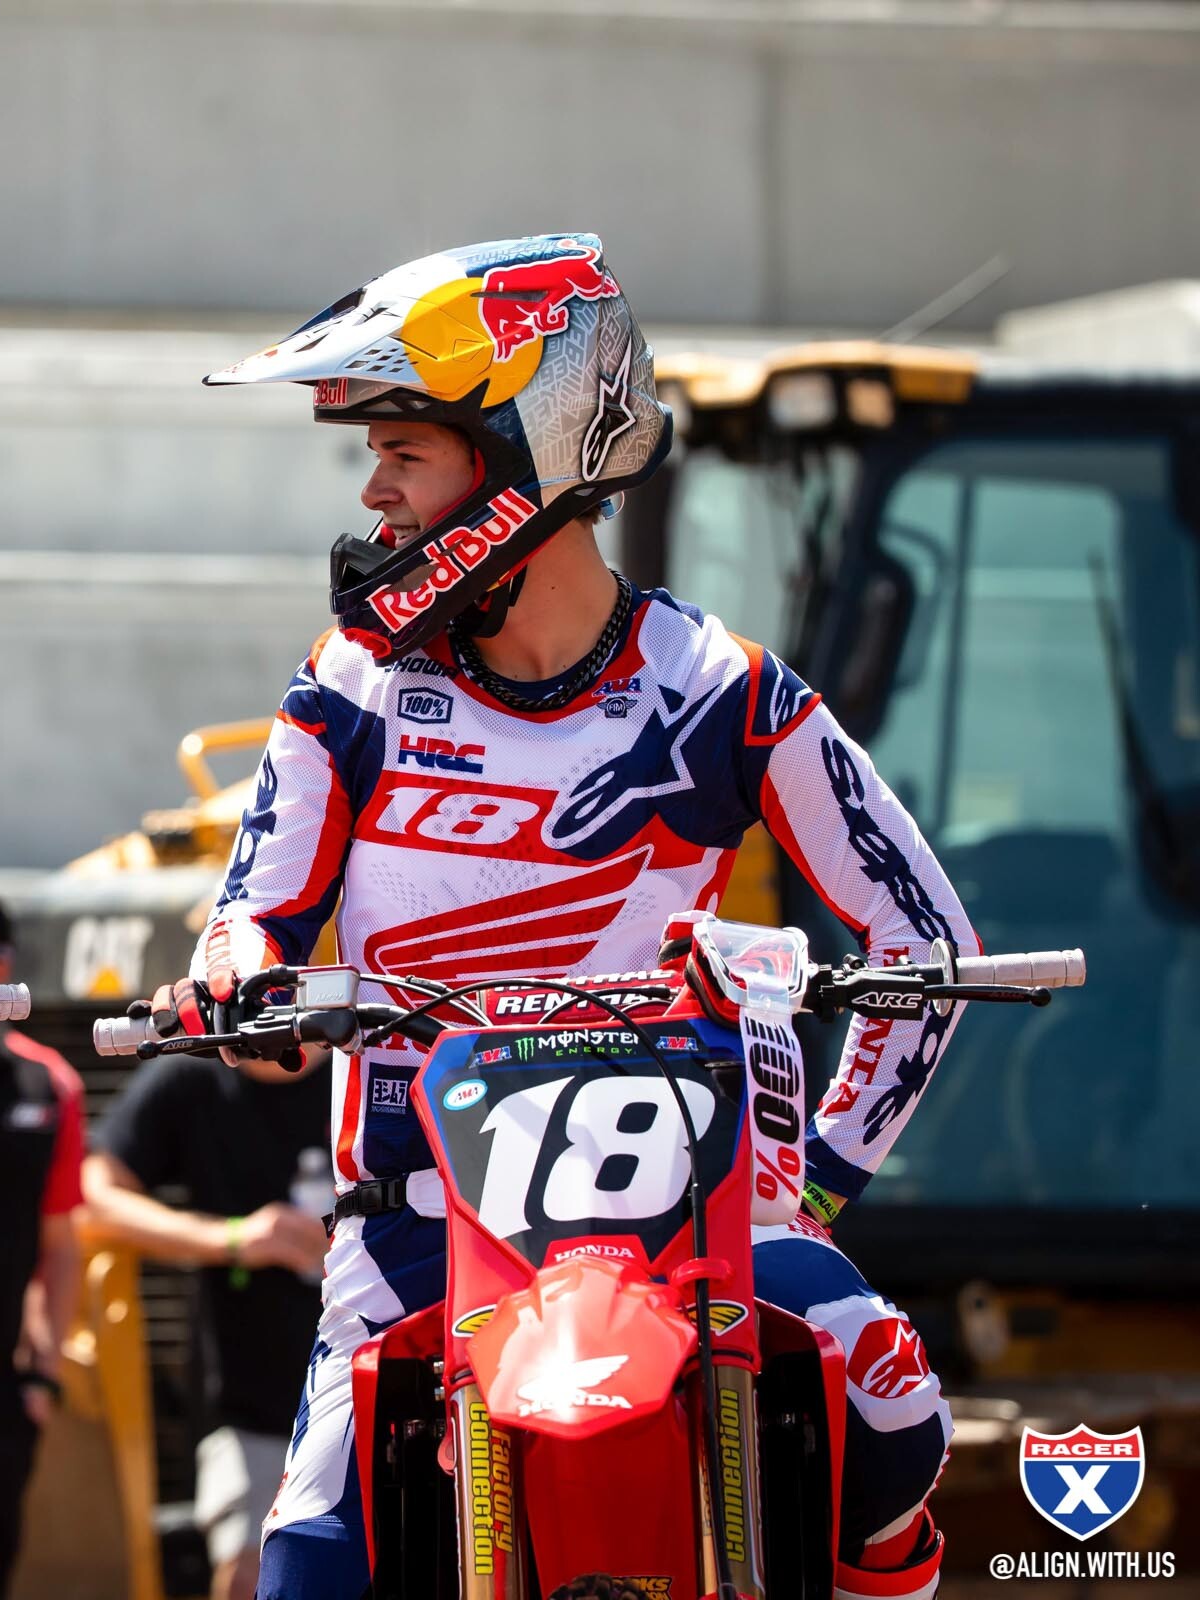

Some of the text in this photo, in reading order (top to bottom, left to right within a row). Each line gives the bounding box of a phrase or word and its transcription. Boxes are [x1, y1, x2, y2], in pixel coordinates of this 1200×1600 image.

[365, 487, 539, 634] Red Bull
[404, 694, 446, 718] 100%
[397, 733, 486, 775] HRC
[375, 785, 541, 846] 18
[851, 991, 923, 1010] ARC
[555, 1046, 633, 1057] ENERGY
[655, 1035, 700, 1052] AMA
[468, 1046, 512, 1068] AMA
[478, 1075, 716, 1238] 18
[554, 1244, 636, 1263] HONDA
[491, 1429, 513, 1553] Factory
